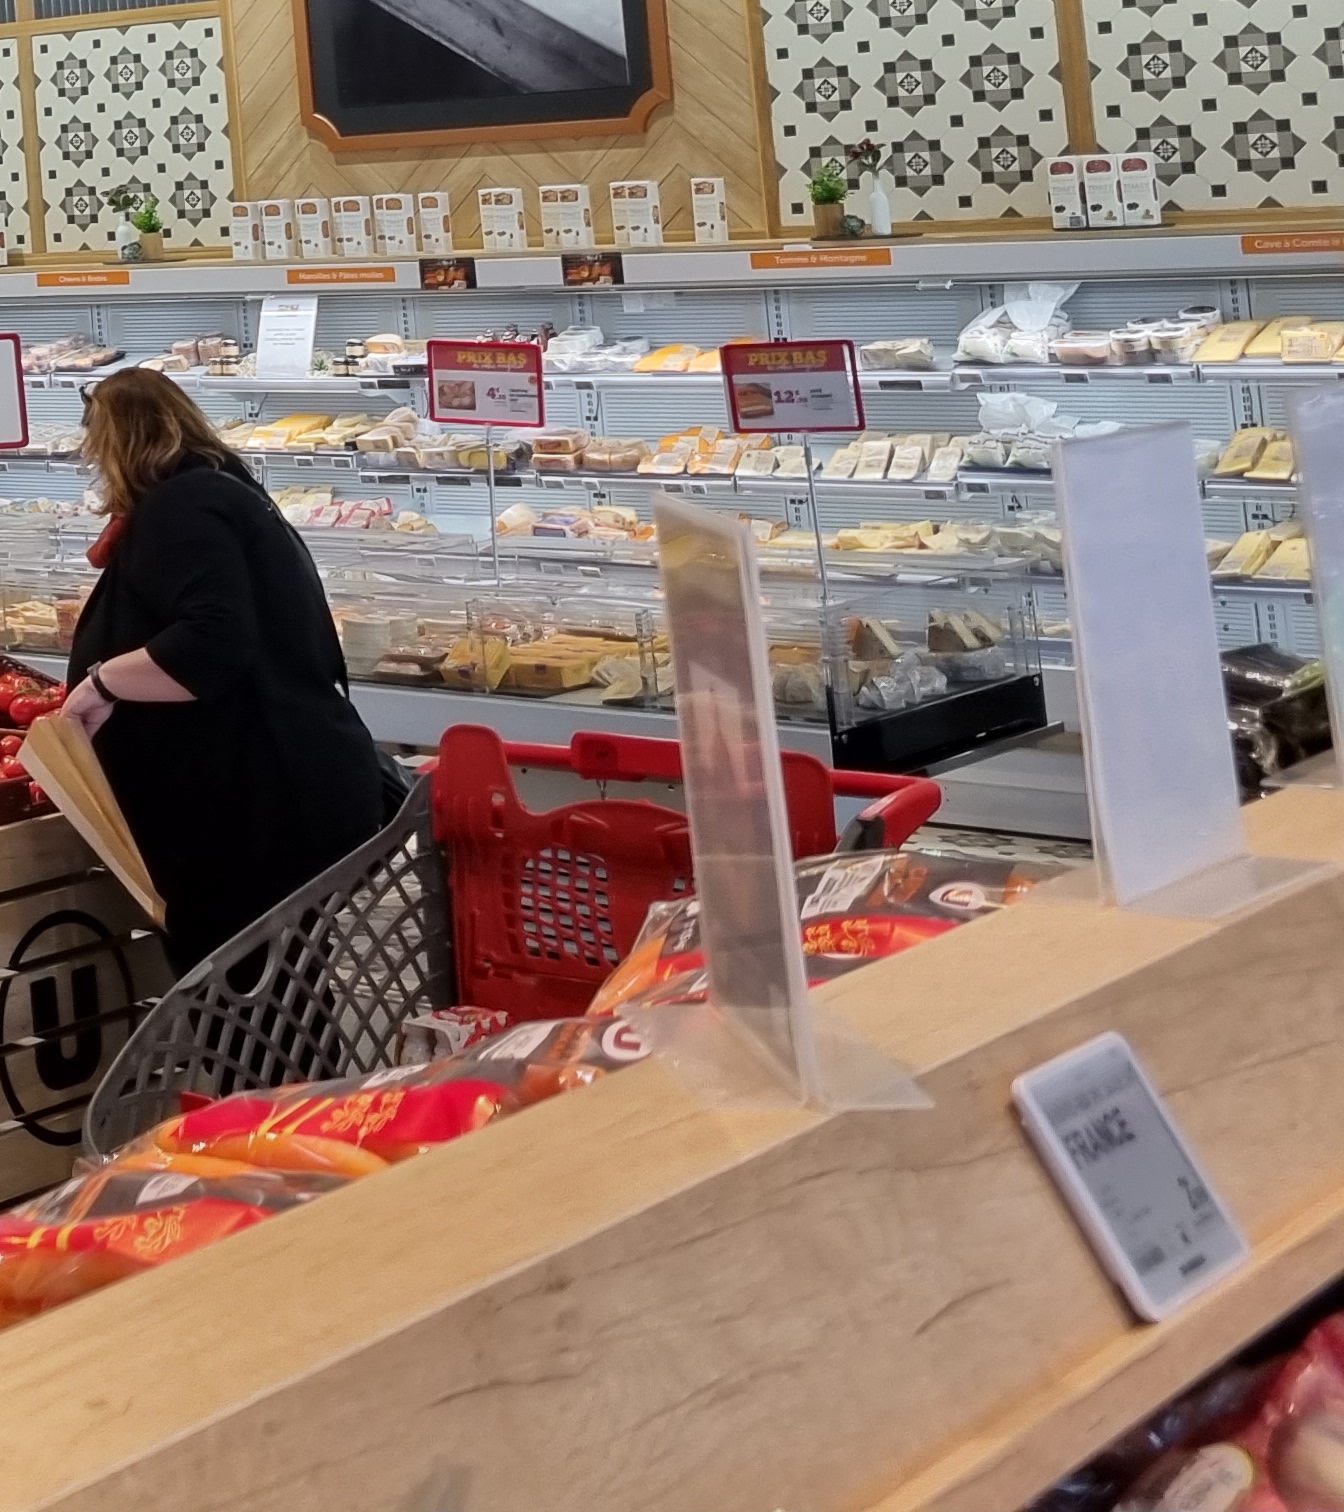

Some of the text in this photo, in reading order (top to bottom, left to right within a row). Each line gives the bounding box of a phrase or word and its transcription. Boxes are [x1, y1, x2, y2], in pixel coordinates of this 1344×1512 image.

[455, 350, 528, 365] PRIX BAS
[746, 349, 829, 367] PRIX BAS
[29, 963, 102, 1091] U
[1062, 1106, 1137, 1171] FRANCE
